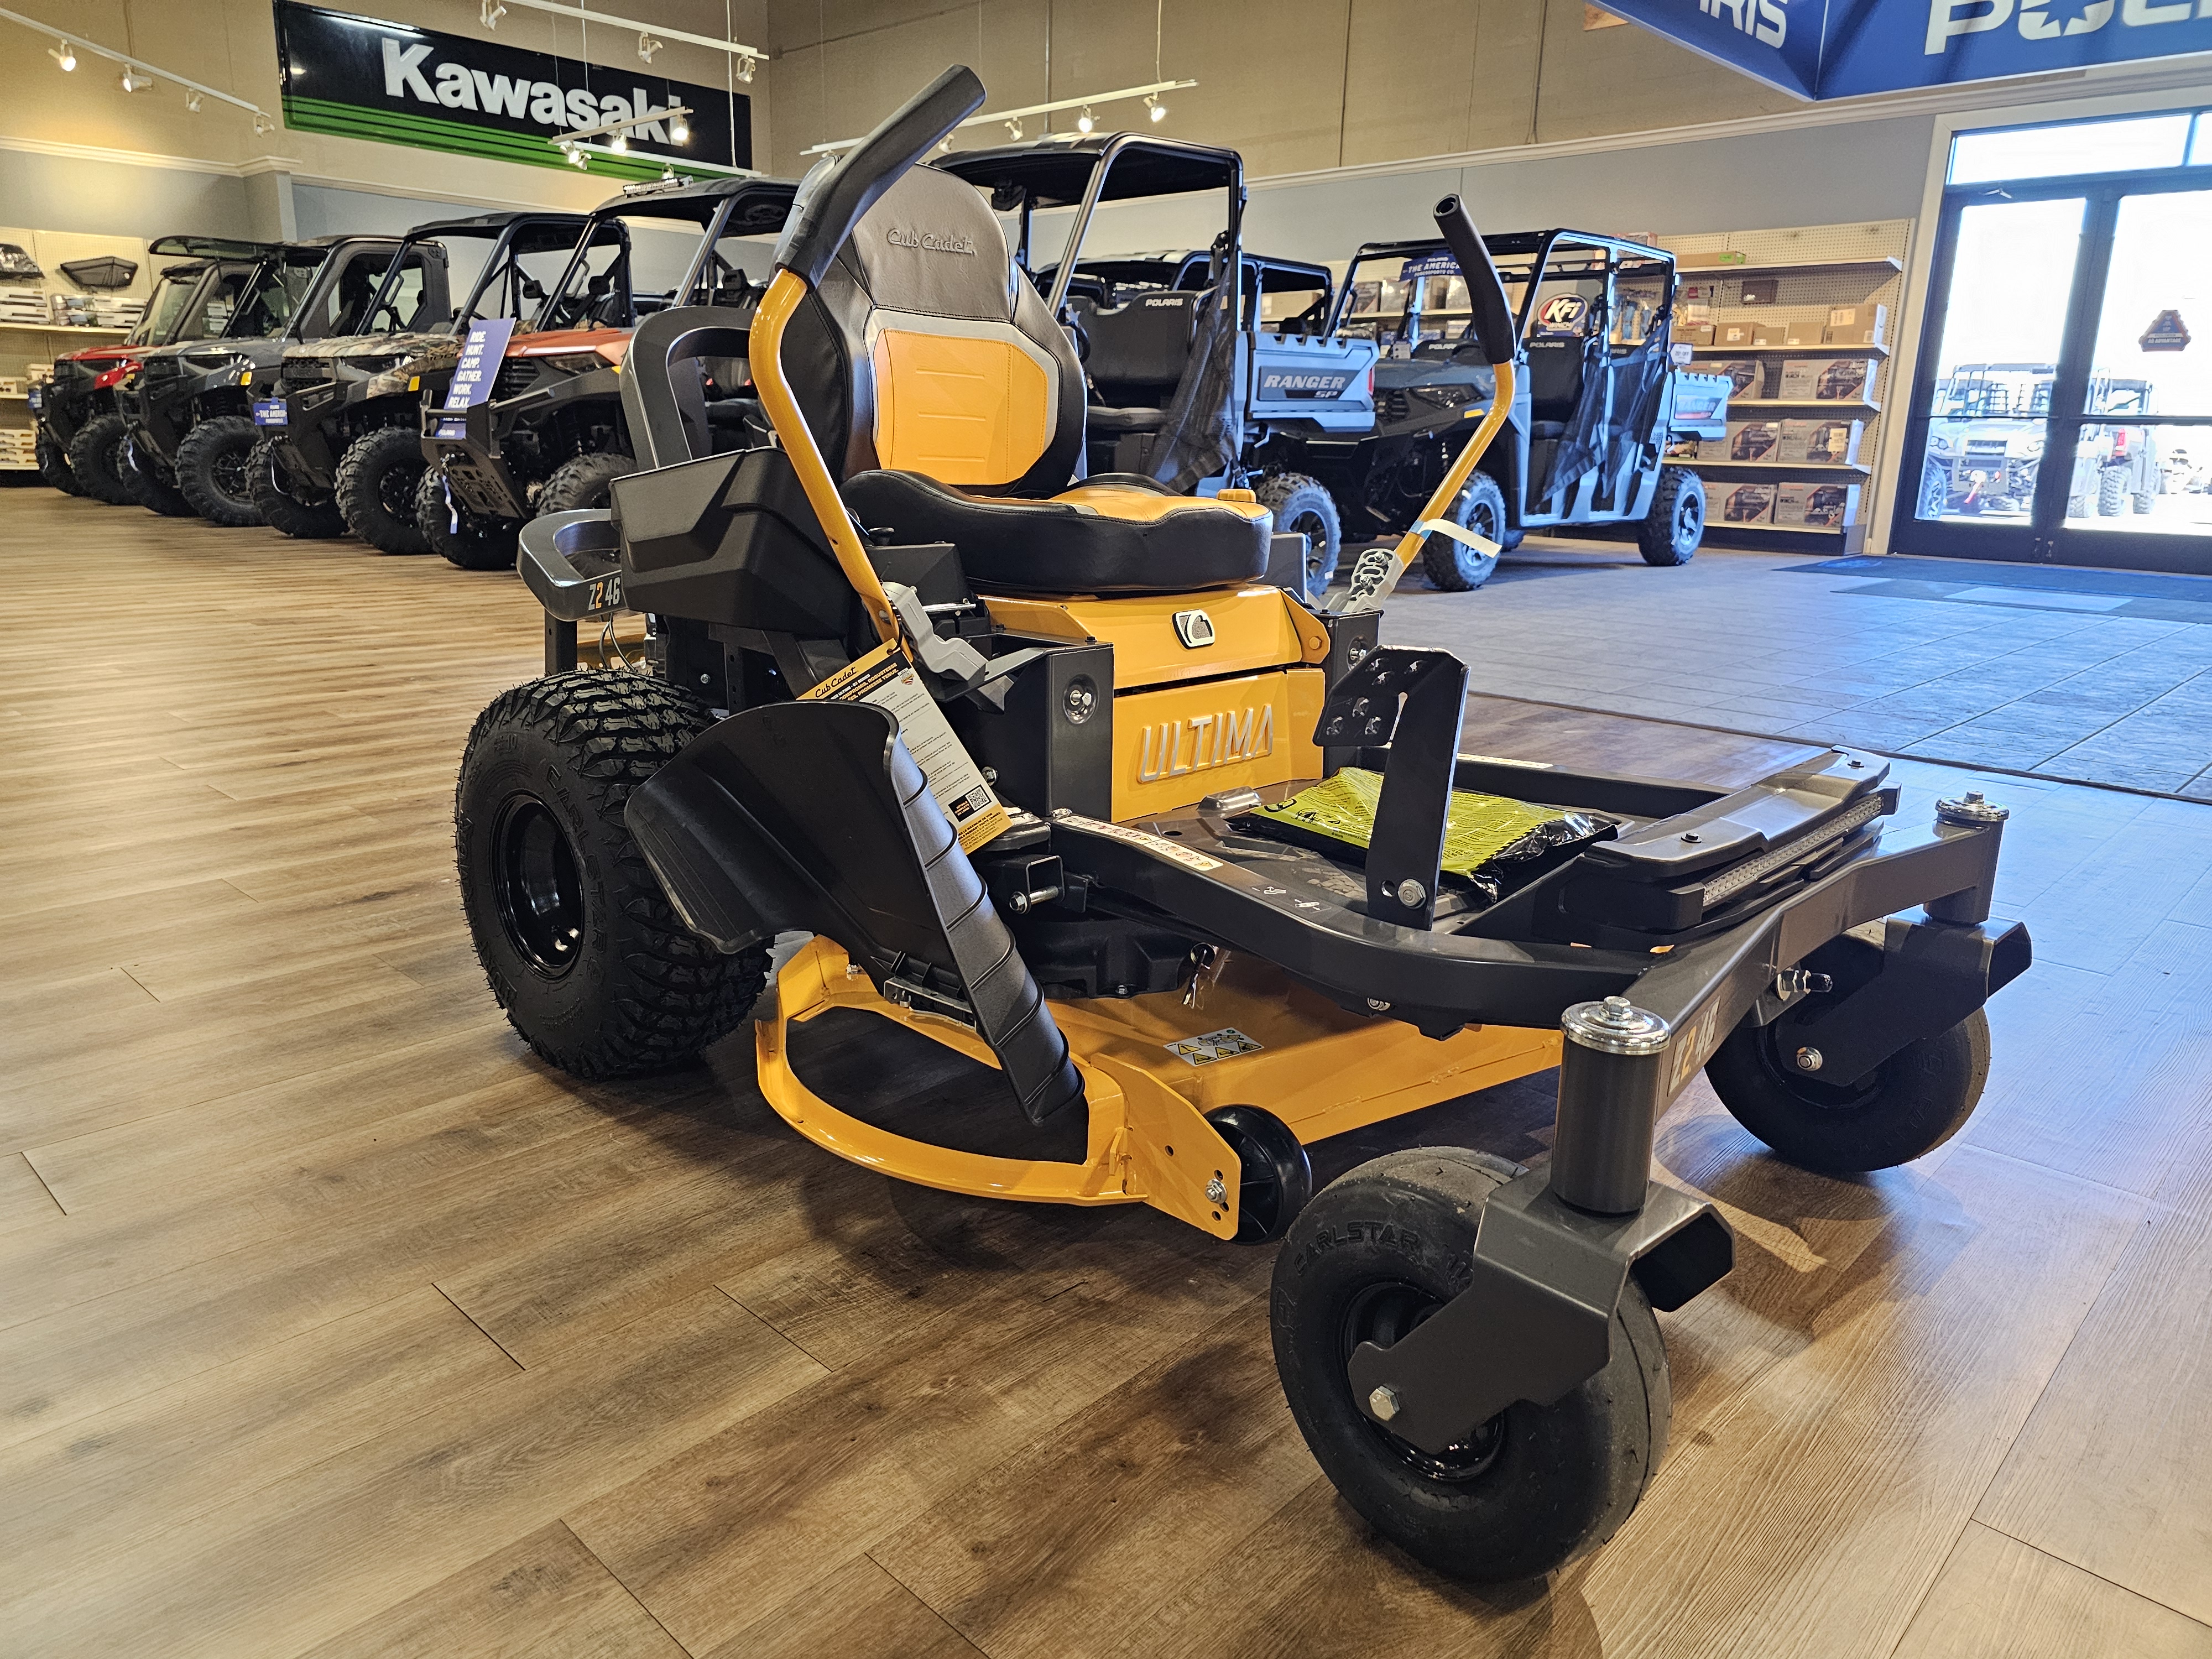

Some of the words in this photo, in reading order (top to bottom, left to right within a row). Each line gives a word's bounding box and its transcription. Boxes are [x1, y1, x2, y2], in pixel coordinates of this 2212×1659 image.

[382, 38, 684, 147] Kawasaki
[886, 228, 919, 247] Cub
[921, 232, 974, 254] Cadet
[1408, 264, 1423, 273] THE
[1145, 298, 1183, 307] POLARIS
[470, 331, 486, 343] RIDE.
[466, 344, 484, 356] HUNT.
[461, 357, 480, 369] CAMP.
[457, 371, 482, 382] GATHER.
[1264, 374, 1346, 390] RANGER
[453, 383, 472, 395] WORK.
[1314, 390, 1339, 399] SP
[448, 397, 469, 408] RELAX.
[1678, 400, 1716, 411] RANGER
[588, 582, 603, 611] Z2
[604, 577, 620, 606] 46
[867, 662, 898, 684] ROBUSTESSE
[815, 684, 831, 697] Cub
[831, 667, 857, 687] Cadet
[857, 677, 883, 696] PROMESSE
[881, 667, 899, 680] TENUE.
[1138, 703, 1274, 782] ULTIMA
[1669, 1025, 1697, 1094] Z2
[1293, 1220, 1421, 1276] CARLSTAR
